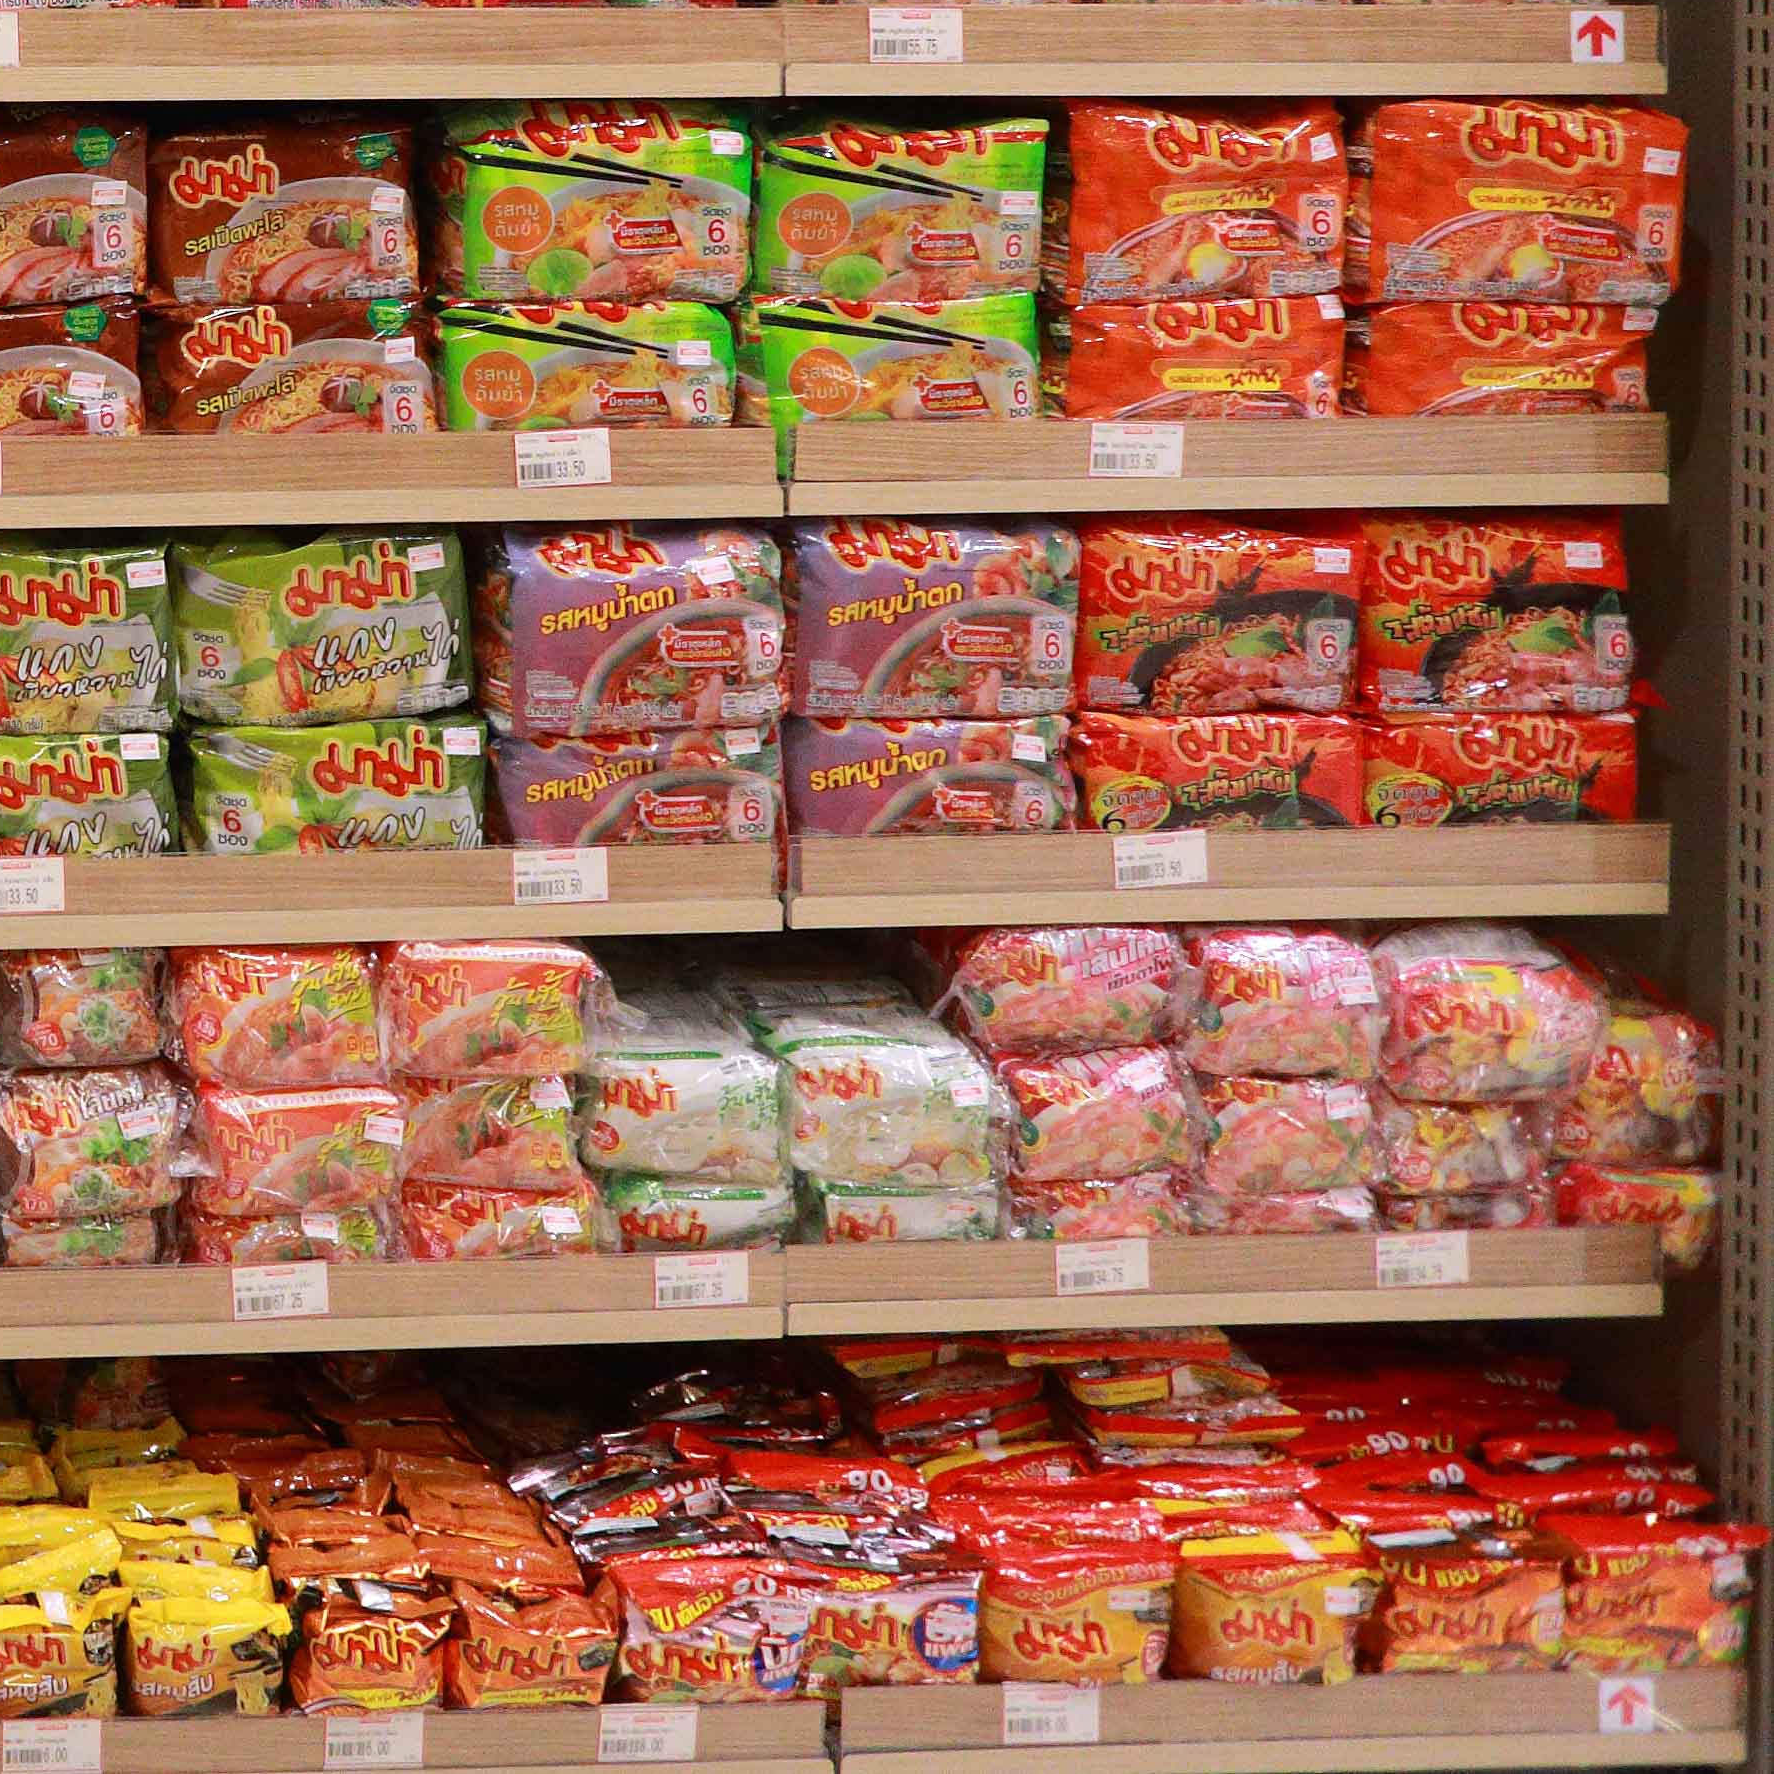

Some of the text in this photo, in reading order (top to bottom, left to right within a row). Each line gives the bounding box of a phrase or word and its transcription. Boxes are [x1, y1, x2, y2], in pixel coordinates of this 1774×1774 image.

[105, 225, 122, 250] 6
[707, 218, 726, 242] 6
[1005, 234, 1022, 258] 6
[557, 460, 586, 478] 33.50
[286, 543, 413, 616] มาม่า
[540, 583, 676, 634] รสหมูน้ำตก
[827, 580, 963, 627] รสหมูน้ำตก
[1319, 634, 1337, 660] 6
[1609, 634, 1627, 659] 6
[8, 888, 38, 905] 33.50
